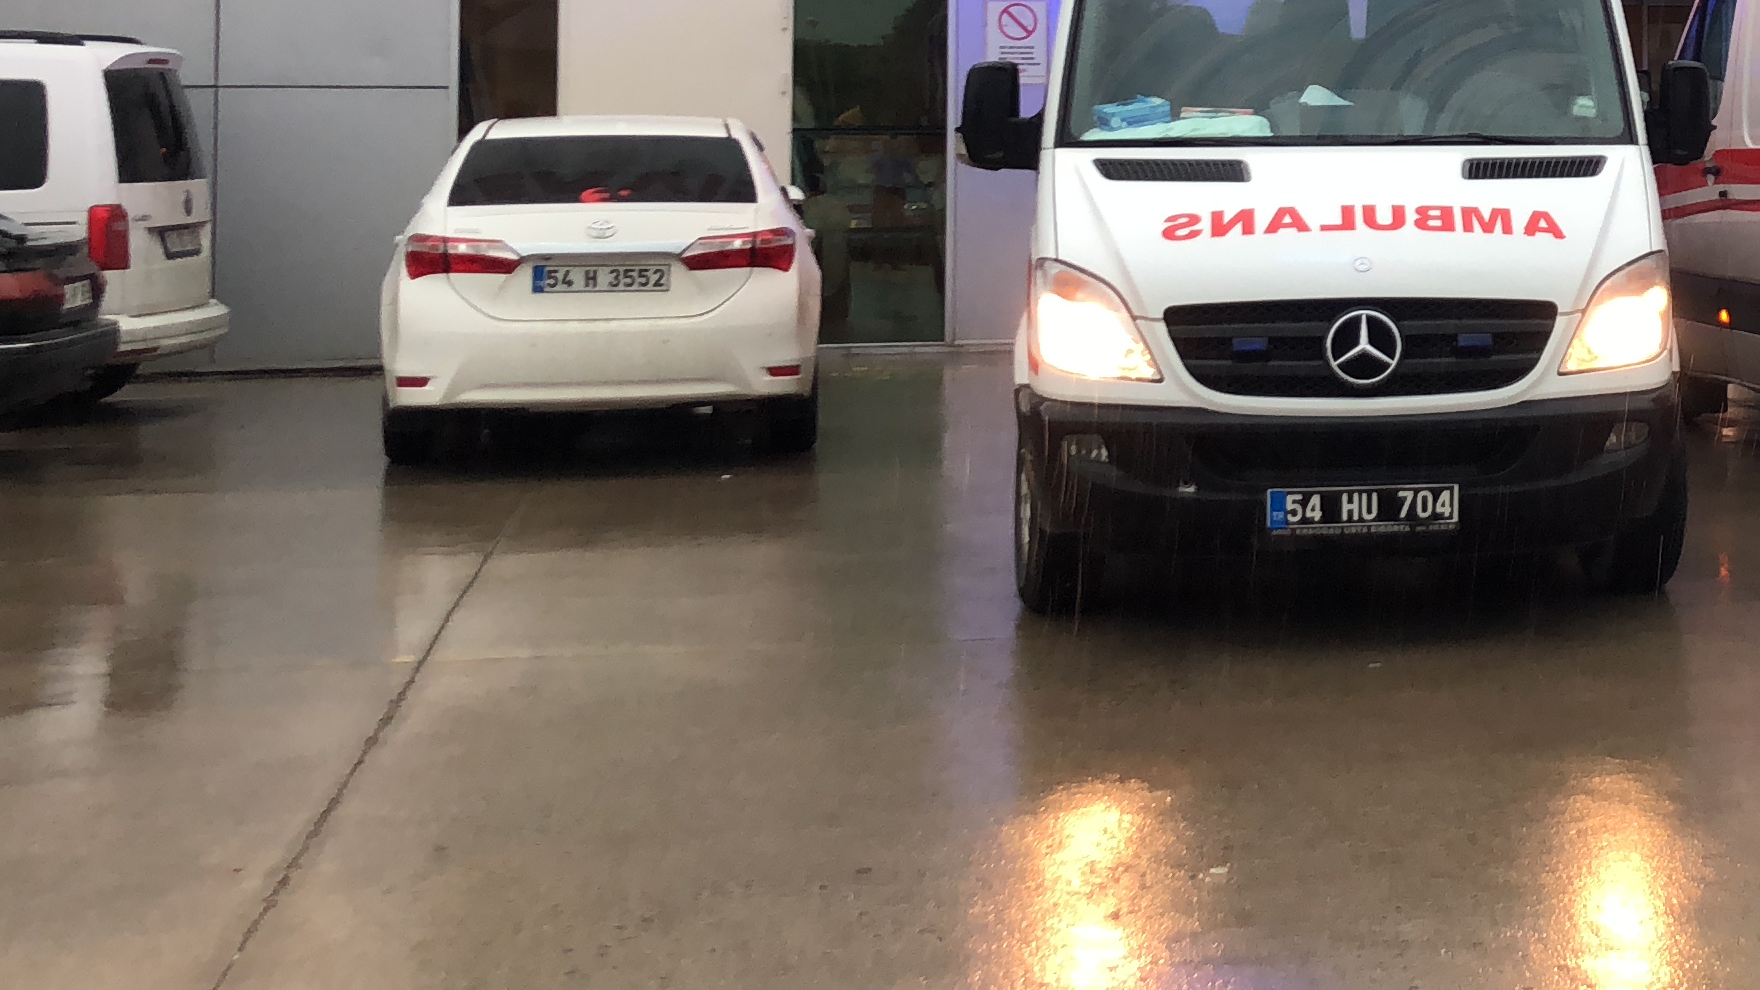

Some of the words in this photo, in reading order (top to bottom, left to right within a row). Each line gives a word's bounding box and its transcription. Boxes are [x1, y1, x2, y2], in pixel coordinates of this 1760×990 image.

[546, 269, 574, 289] 54
[584, 269, 598, 288] H
[608, 268, 666, 288] 3552
[1286, 493, 1322, 522] 54
[1341, 491, 1379, 521] HU
[1397, 489, 1452, 518] 704
